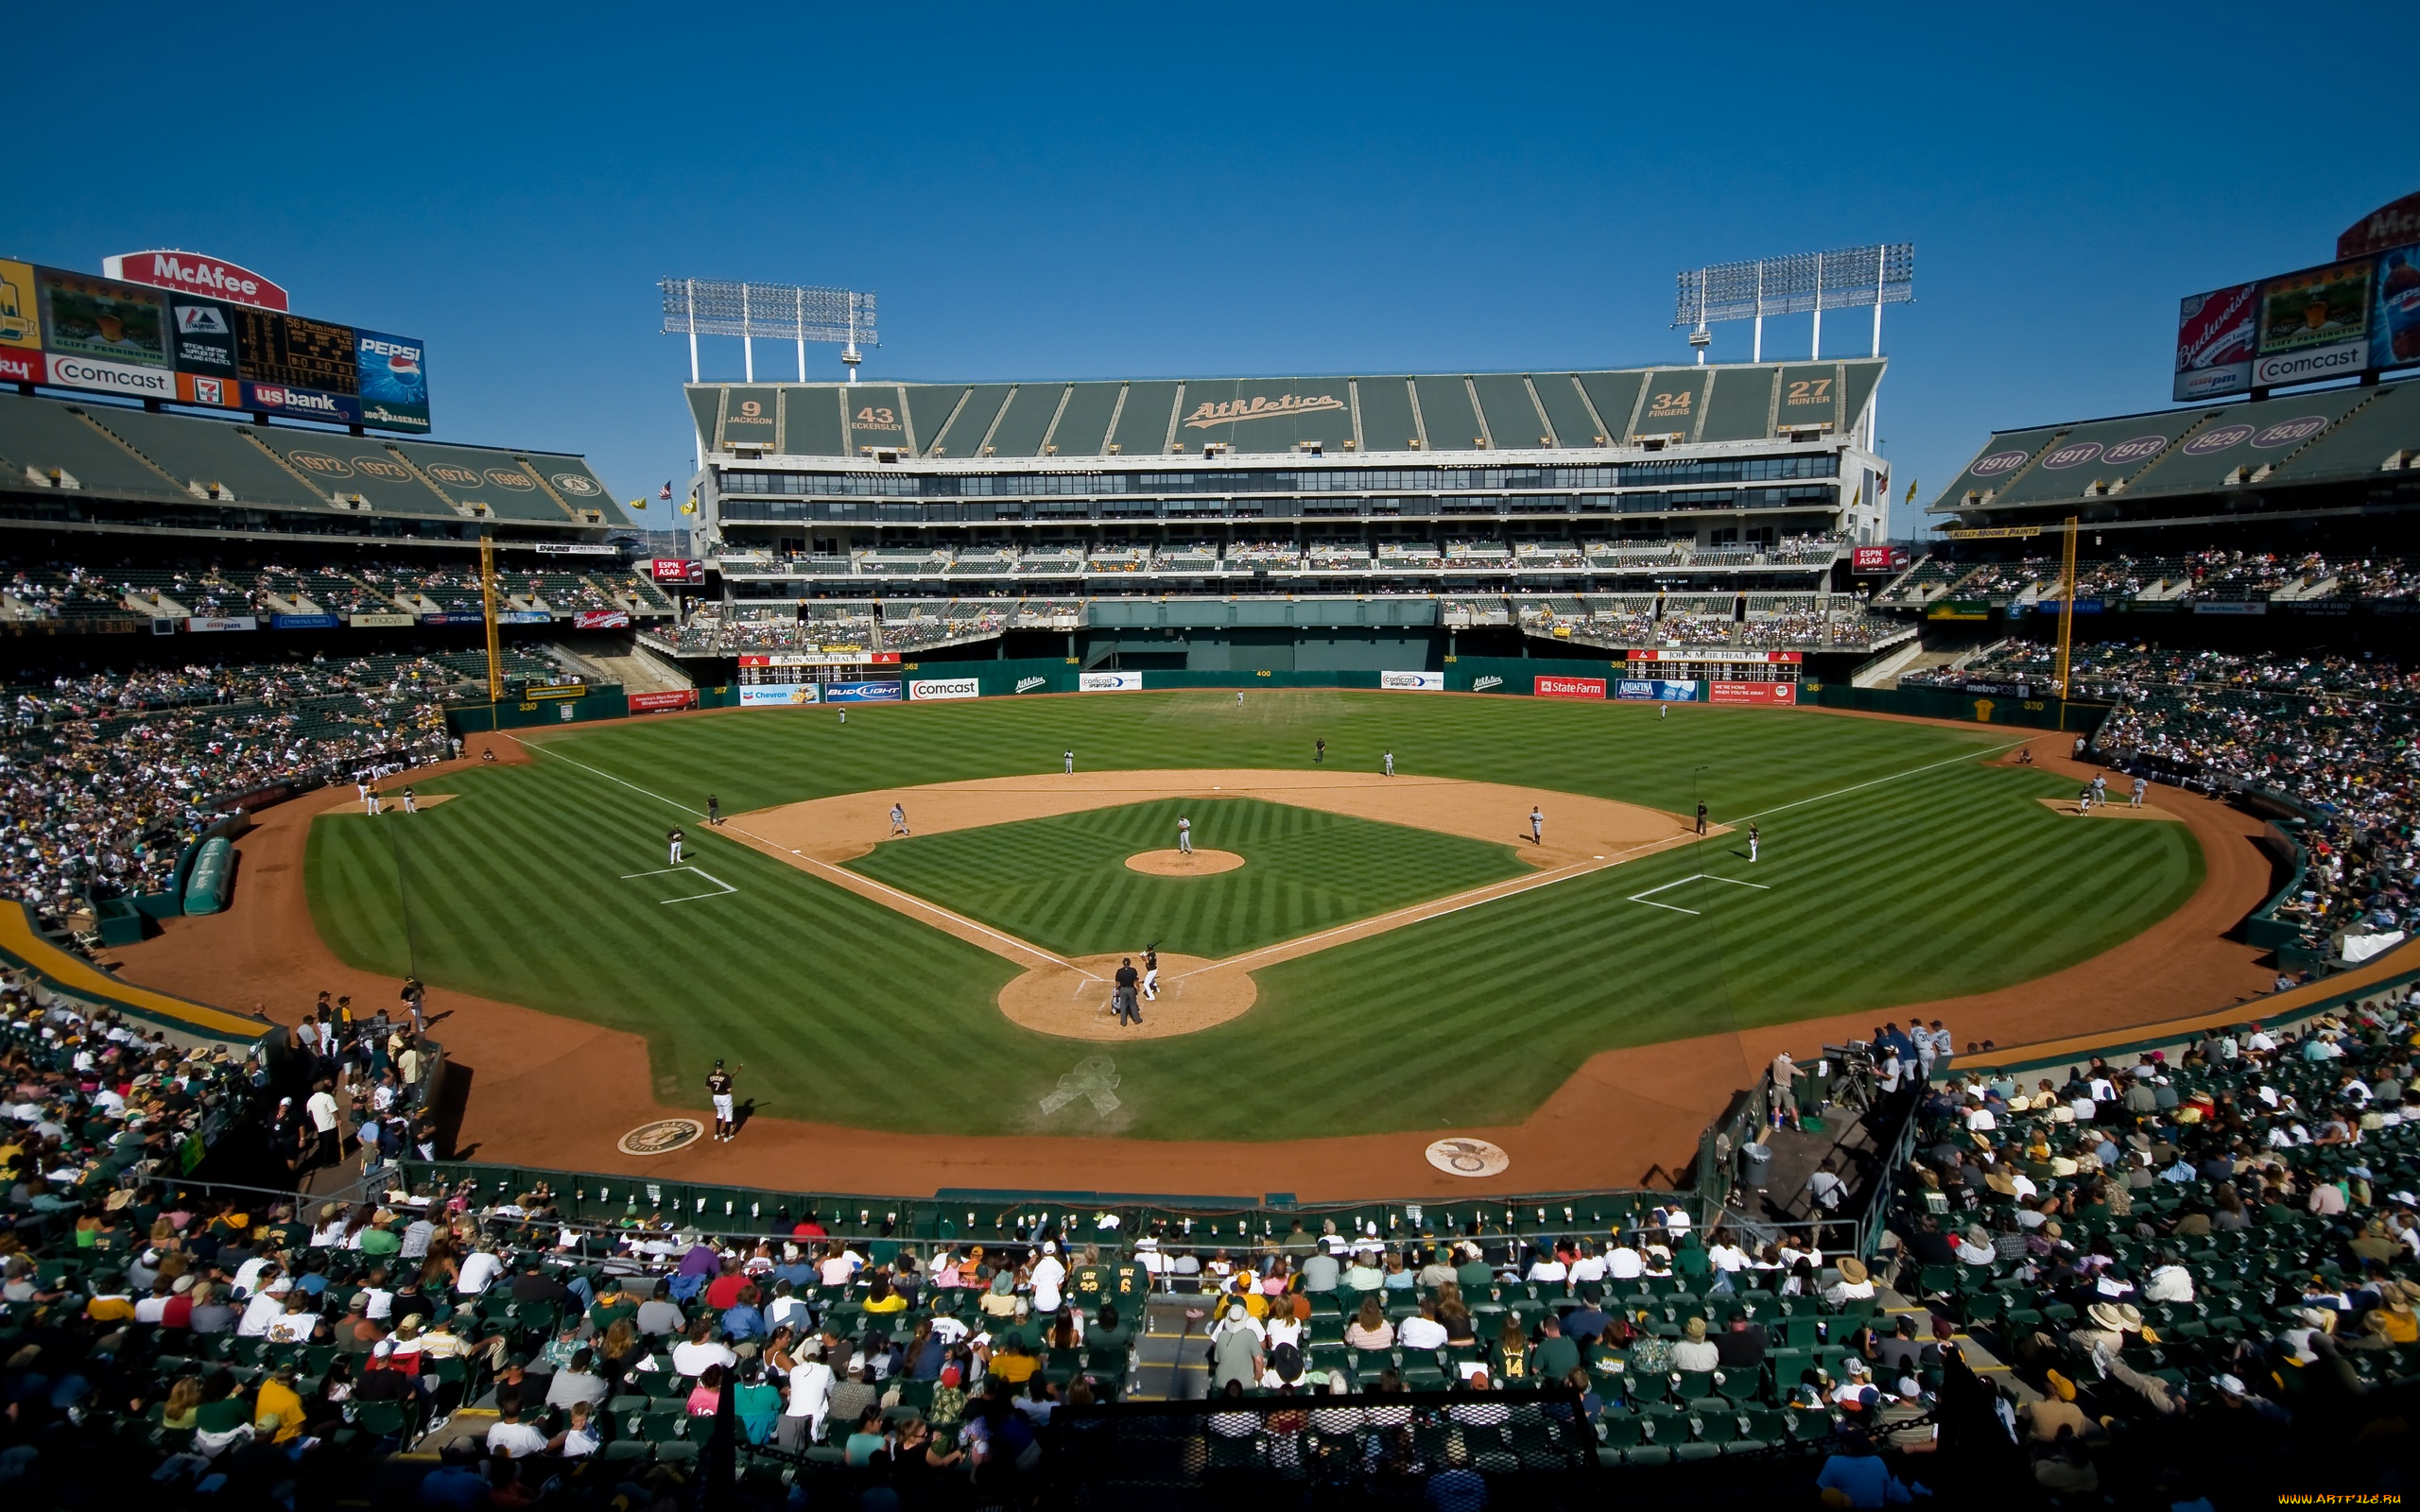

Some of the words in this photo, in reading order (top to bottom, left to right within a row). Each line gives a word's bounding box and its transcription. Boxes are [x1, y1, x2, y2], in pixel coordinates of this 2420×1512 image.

[154, 254, 257, 296] McAfee
[152, 280, 261, 306] COLISEUM
[185, 322, 217, 331] Majestic
[286, 318, 301, 329] 56
[303, 321, 352, 337] Pennington
[2177, 283, 2258, 371] Budweiser
[2265, 339, 2292, 349] CLIFF
[2297, 326, 2361, 343] PENNINGTON
[56, 338, 87, 350] CLIFF
[94, 345, 164, 361] PENNINGTON
[182, 342, 204, 351] OFFICIAL
[205, 345, 228, 354] UNIFORM
[185, 348, 208, 356] SUPPLIER
[361, 338, 421, 361] PEPSI
[180, 352, 204, 361] OAKLAND
[2267, 348, 2359, 377] comcast
[62, 363, 165, 390] comcast
[2188, 374, 2238, 387] ampm
[200, 382, 217, 403] 7
[1789, 379, 1832, 398] 27
[1651, 391, 1692, 410] 34
[1788, 395, 1830, 406] HUNTER
[741, 401, 762, 417] 9
[857, 407, 894, 423] 43
[1183, 394, 1343, 424] Athletics
[1648, 407, 1690, 418] FINGERS
[388, 414, 428, 425] BASEBALL
[727, 416, 772, 425] JACKSON
[851, 422, 903, 432] ECKERSLEY
[2260, 421, 2318, 442] 1930
[2194, 429, 2245, 450] 1929
[2048, 446, 2097, 464] 1911
[2111, 439, 2158, 458] 1913
[296, 455, 349, 472] 1972
[358, 459, 406, 478] 1973
[1979, 455, 2028, 471] 1910
[433, 467, 478, 483] 1974
[489, 472, 531, 487] 1989
[1953, 529, 2006, 539] KELLY-MOORE
[2008, 527, 2038, 536] PAINTS
[1858, 557, 1883, 565] ASAP.
[658, 568, 681, 576] ASAP.
[36, 619, 66, 627] STRIKE
[106, 621, 132, 632] 3:10
[206, 621, 241, 630] ampm
[370, 616, 403, 627] macy's
[577, 610, 627, 628] Budweiser
[1697, 651, 1719, 660] MUIR
[904, 662, 918, 671] 362
[918, 680, 976, 695] comcast
[1015, 675, 1046, 693] Athletics
[1473, 676, 1503, 692] Athletics
[1618, 680, 1653, 695] AQUAFINA
[1807, 683, 1824, 692] 367
[1966, 683, 2015, 695] metroPCS
[519, 702, 538, 712] 330
[2024, 700, 2044, 711] 330
[713, 1082, 721, 1091] 7
[1120, 1278, 1131, 1293] 6
[1505, 1358, 1524, 1378] 14
